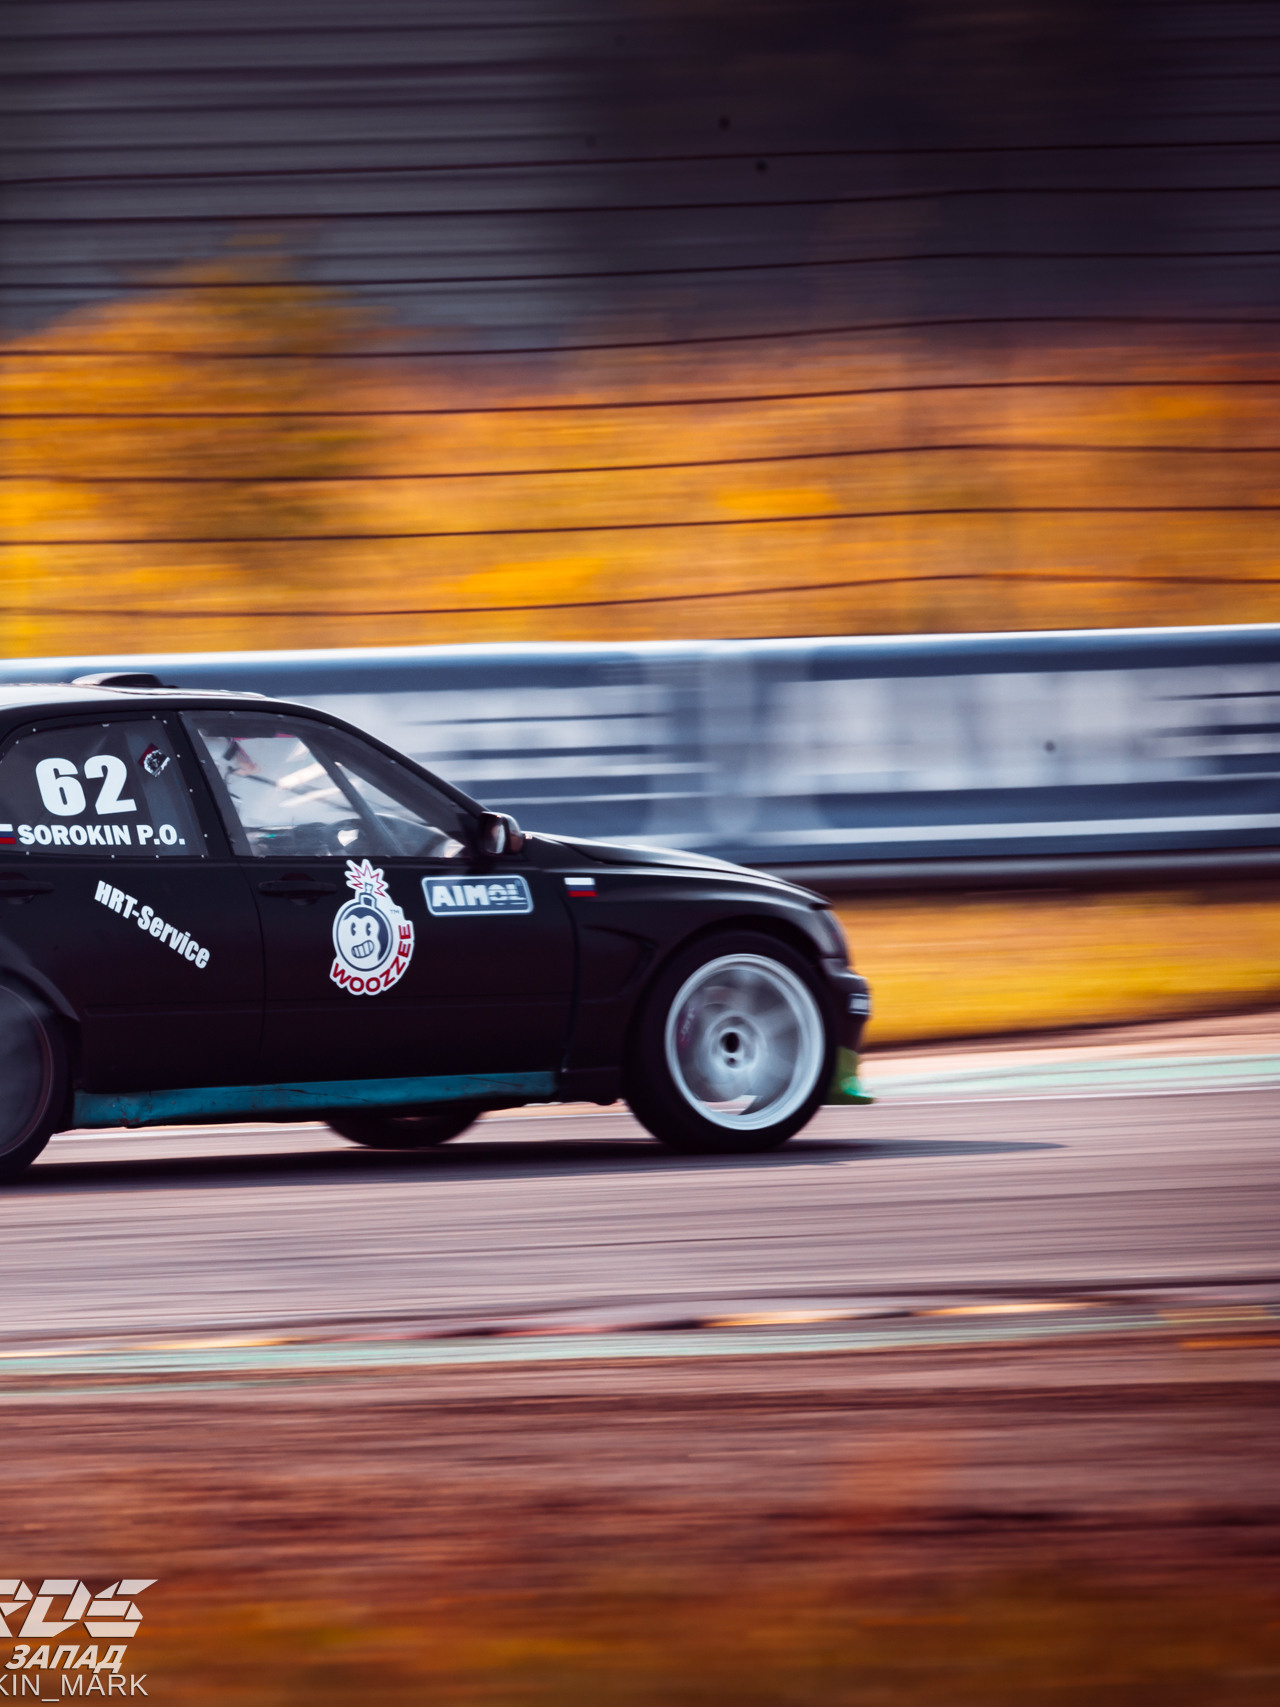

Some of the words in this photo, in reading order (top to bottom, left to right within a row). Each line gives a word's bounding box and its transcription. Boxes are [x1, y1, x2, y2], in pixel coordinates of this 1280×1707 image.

[35, 754, 138, 817] 62
[17, 823, 132, 846] SOROKIN
[135, 823, 186, 846] P.O.
[94, 880, 211, 969] HRT-Service
[431, 883, 527, 908] AIMOL
[332, 923, 412, 993] WOOZZEE
